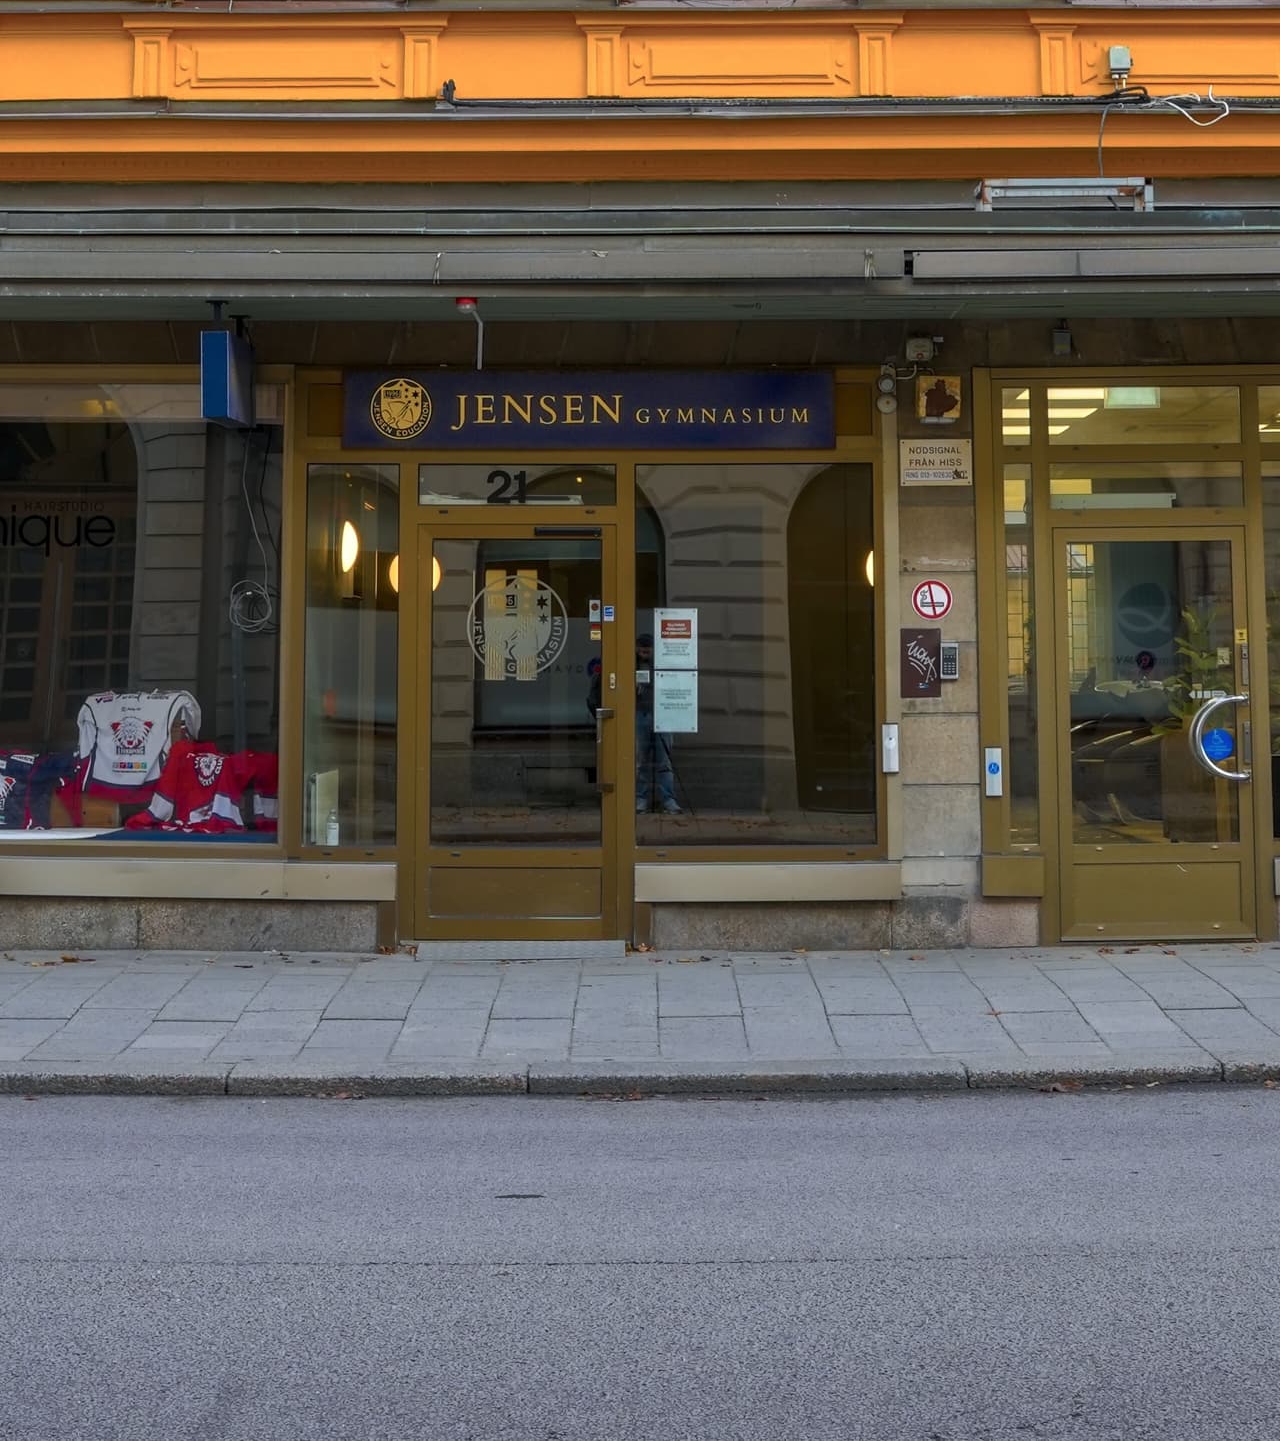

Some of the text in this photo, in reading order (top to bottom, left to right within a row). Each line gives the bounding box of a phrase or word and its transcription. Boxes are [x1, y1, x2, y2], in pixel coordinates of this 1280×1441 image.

[451, 394, 809, 430] JENSEN GYMNASIUM
[909, 457, 962, 467] FRÅN HISS
[486, 470, 527, 504] 21
